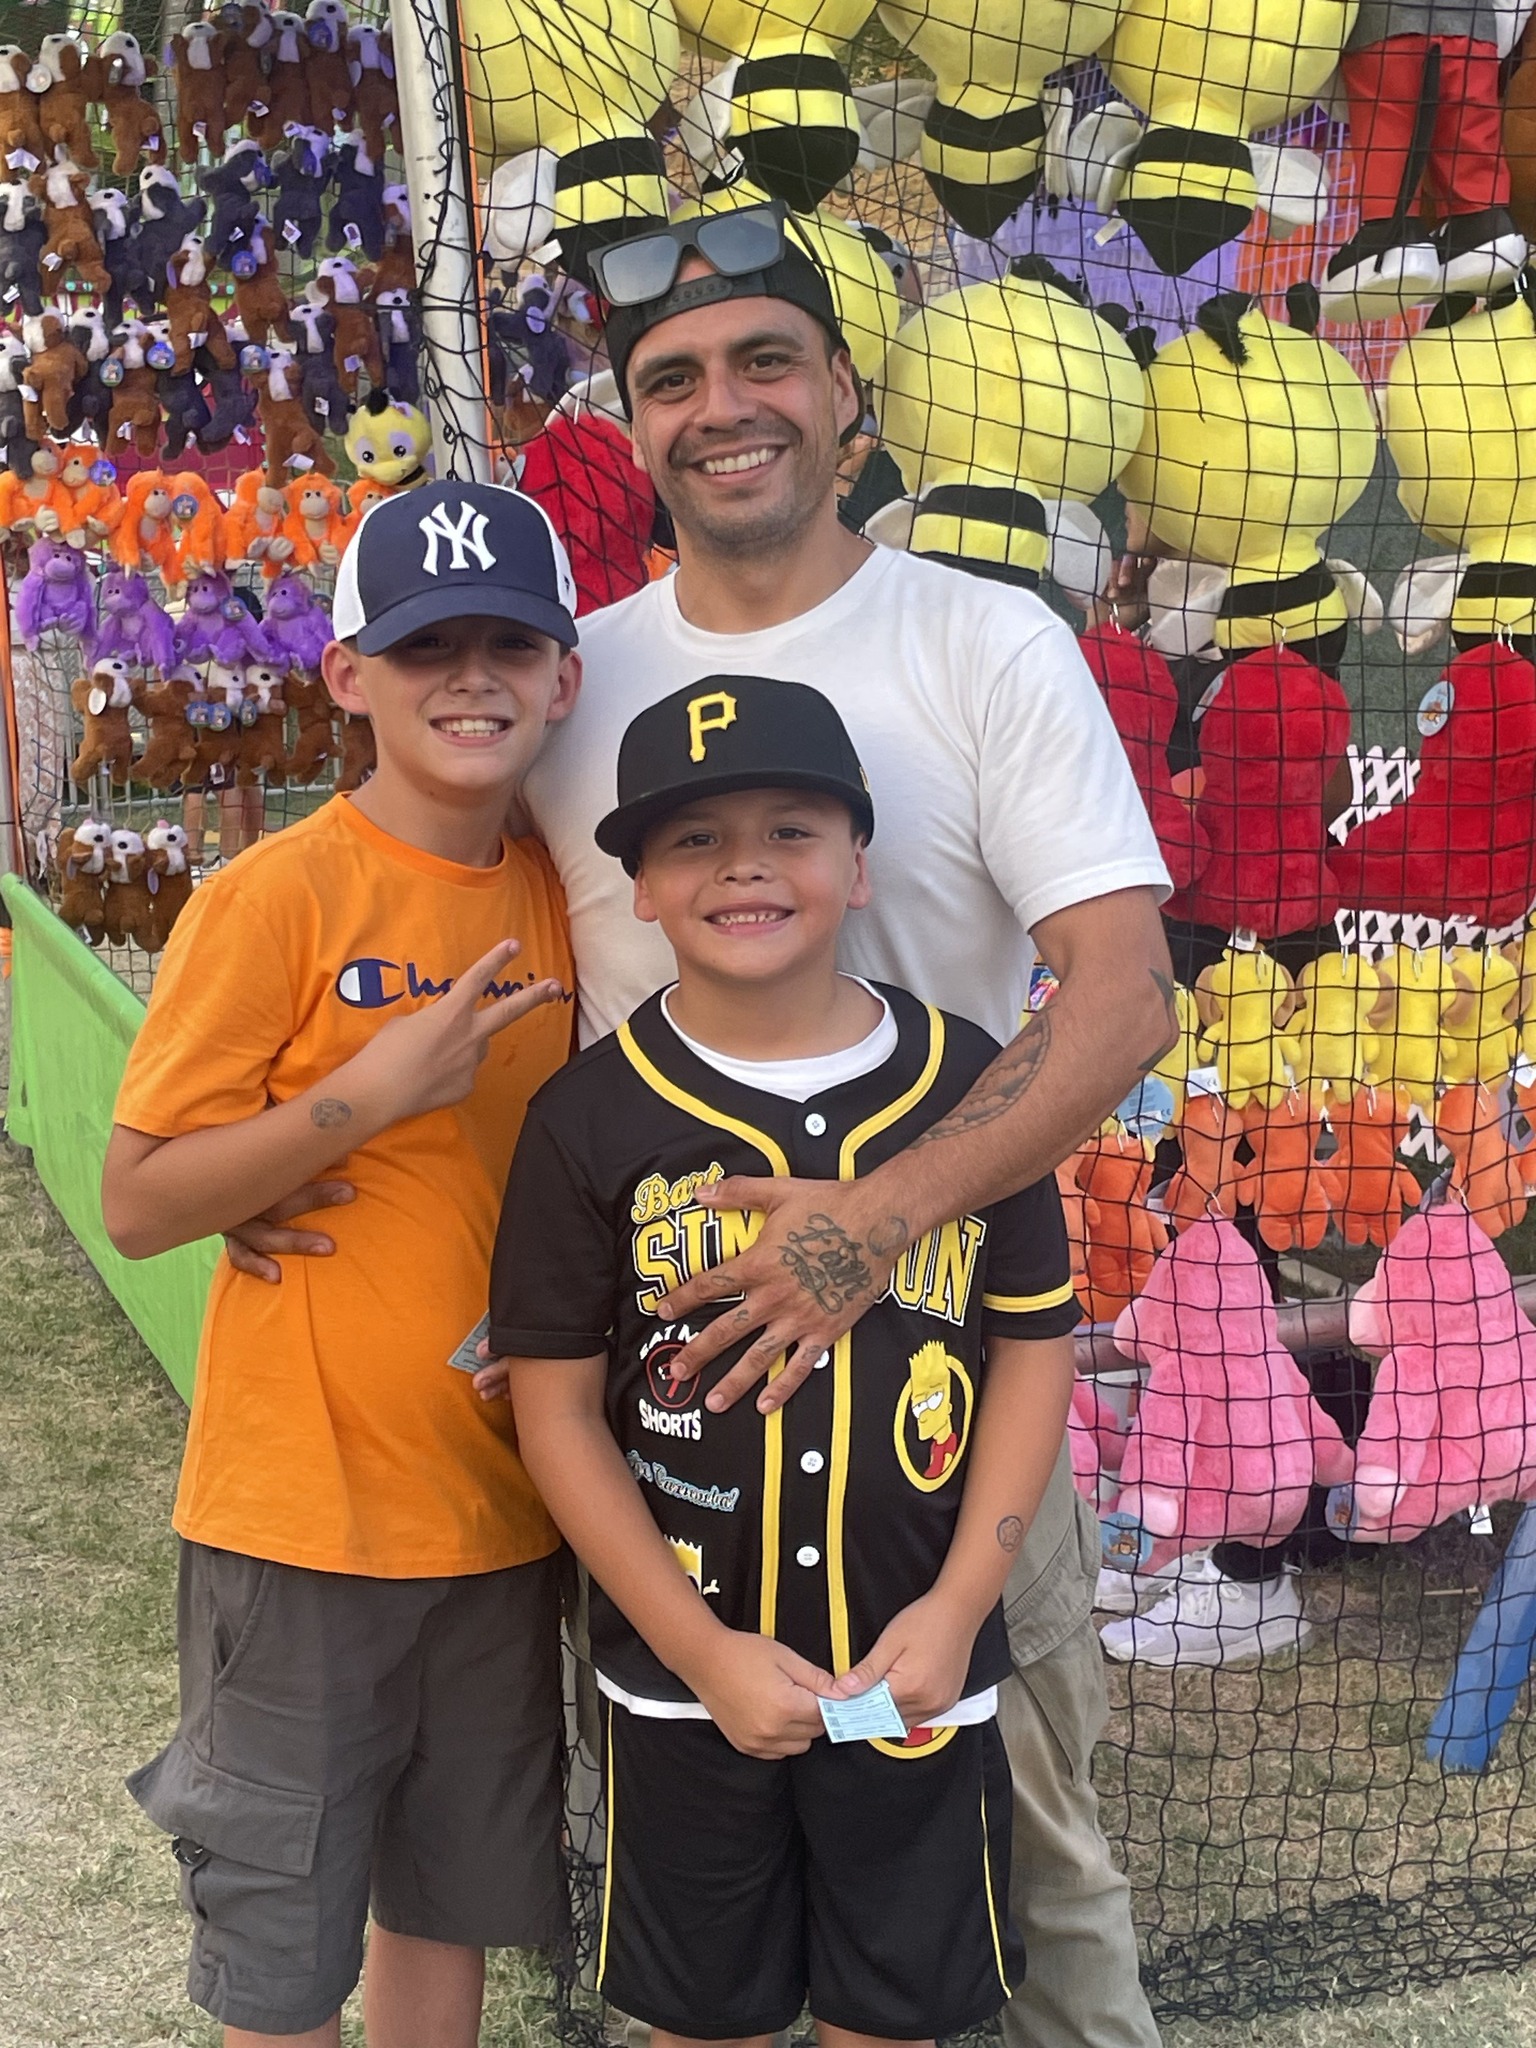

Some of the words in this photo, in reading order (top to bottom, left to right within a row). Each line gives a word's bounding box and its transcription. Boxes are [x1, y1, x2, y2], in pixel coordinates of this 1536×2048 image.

[418, 500, 497, 577] NY
[686, 690, 737, 763] P
[638, 1398, 702, 1441] SHORTS
